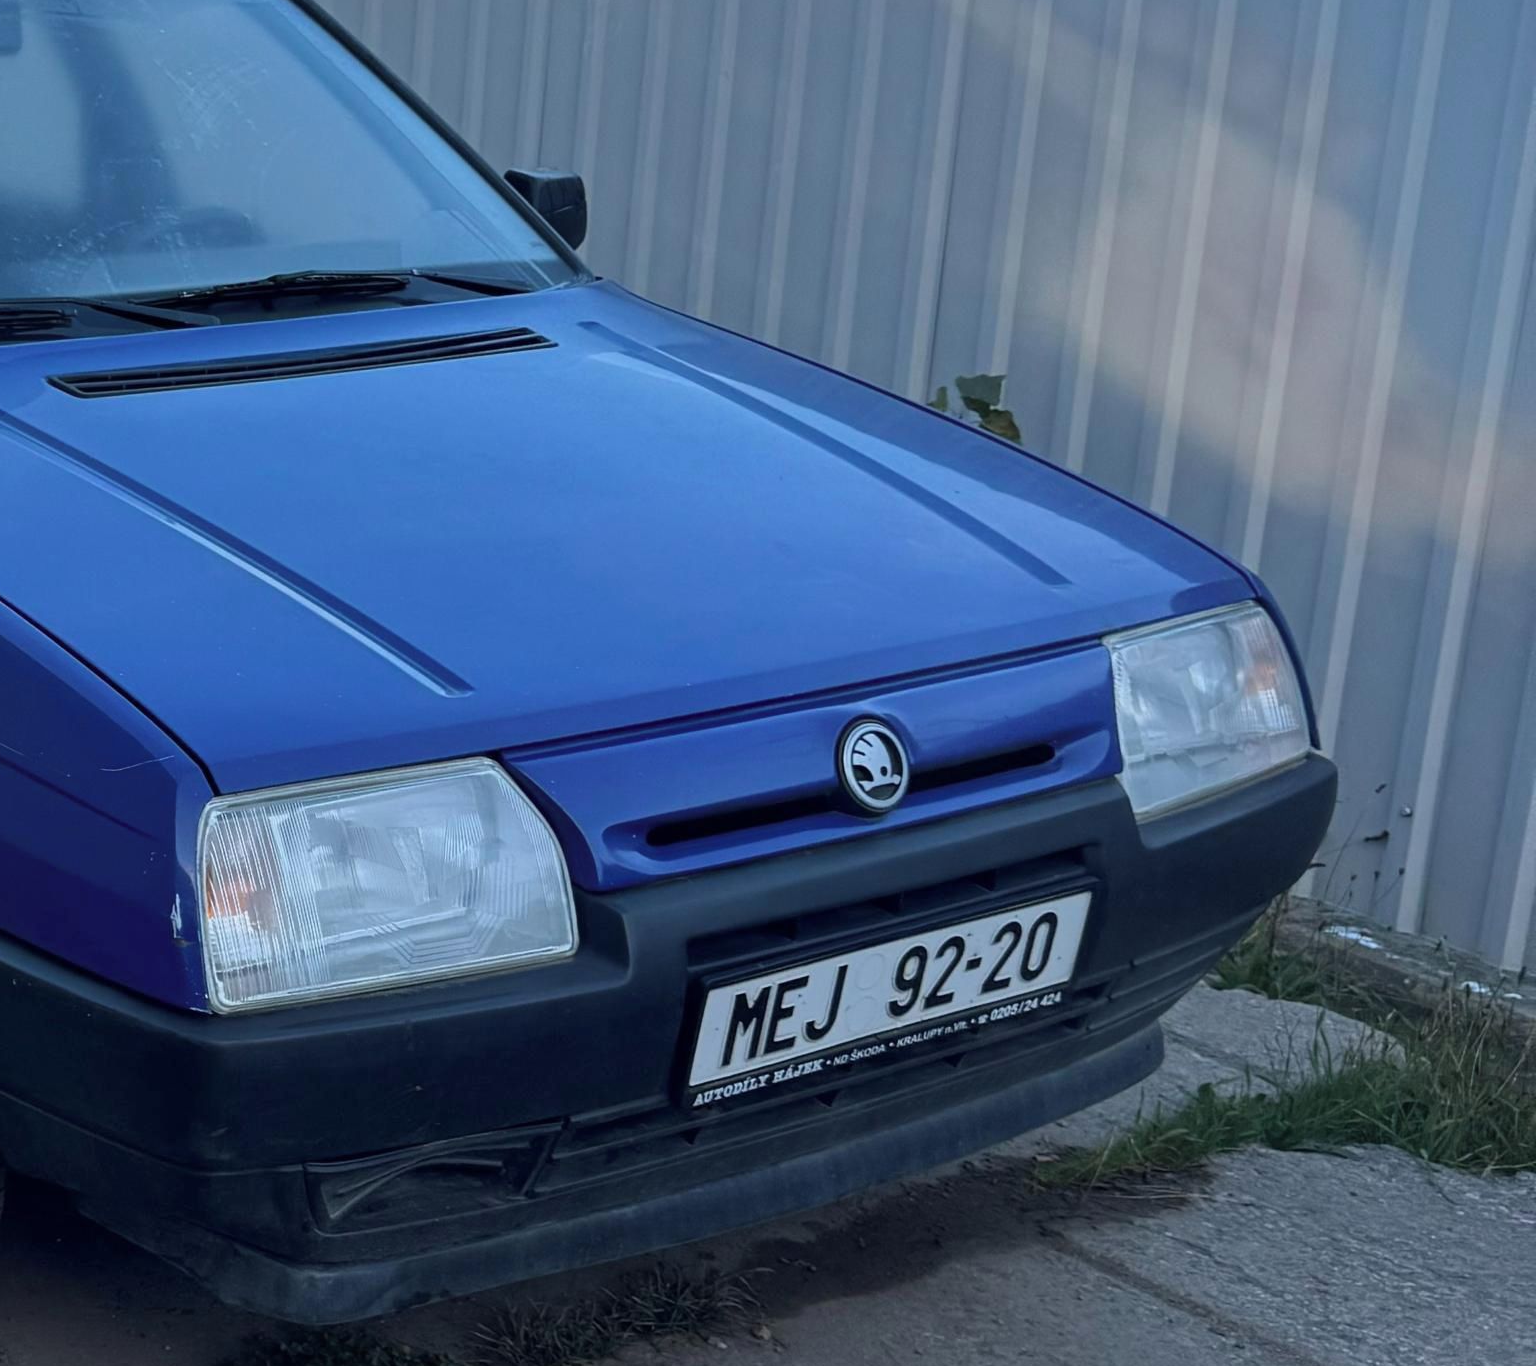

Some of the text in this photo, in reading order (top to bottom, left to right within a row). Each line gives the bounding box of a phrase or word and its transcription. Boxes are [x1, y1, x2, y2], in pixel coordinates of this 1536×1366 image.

[692, 1076, 770, 1107] AUTODÍLY
[772, 1058, 826, 1084] HÁJEK
[850, 1044, 886, 1061] ŠKODA
[896, 1027, 945, 1048] KRALUPY
[1040, 991, 1062, 1006] 424
[720, 911, 1058, 1067] MEJ 92-20
